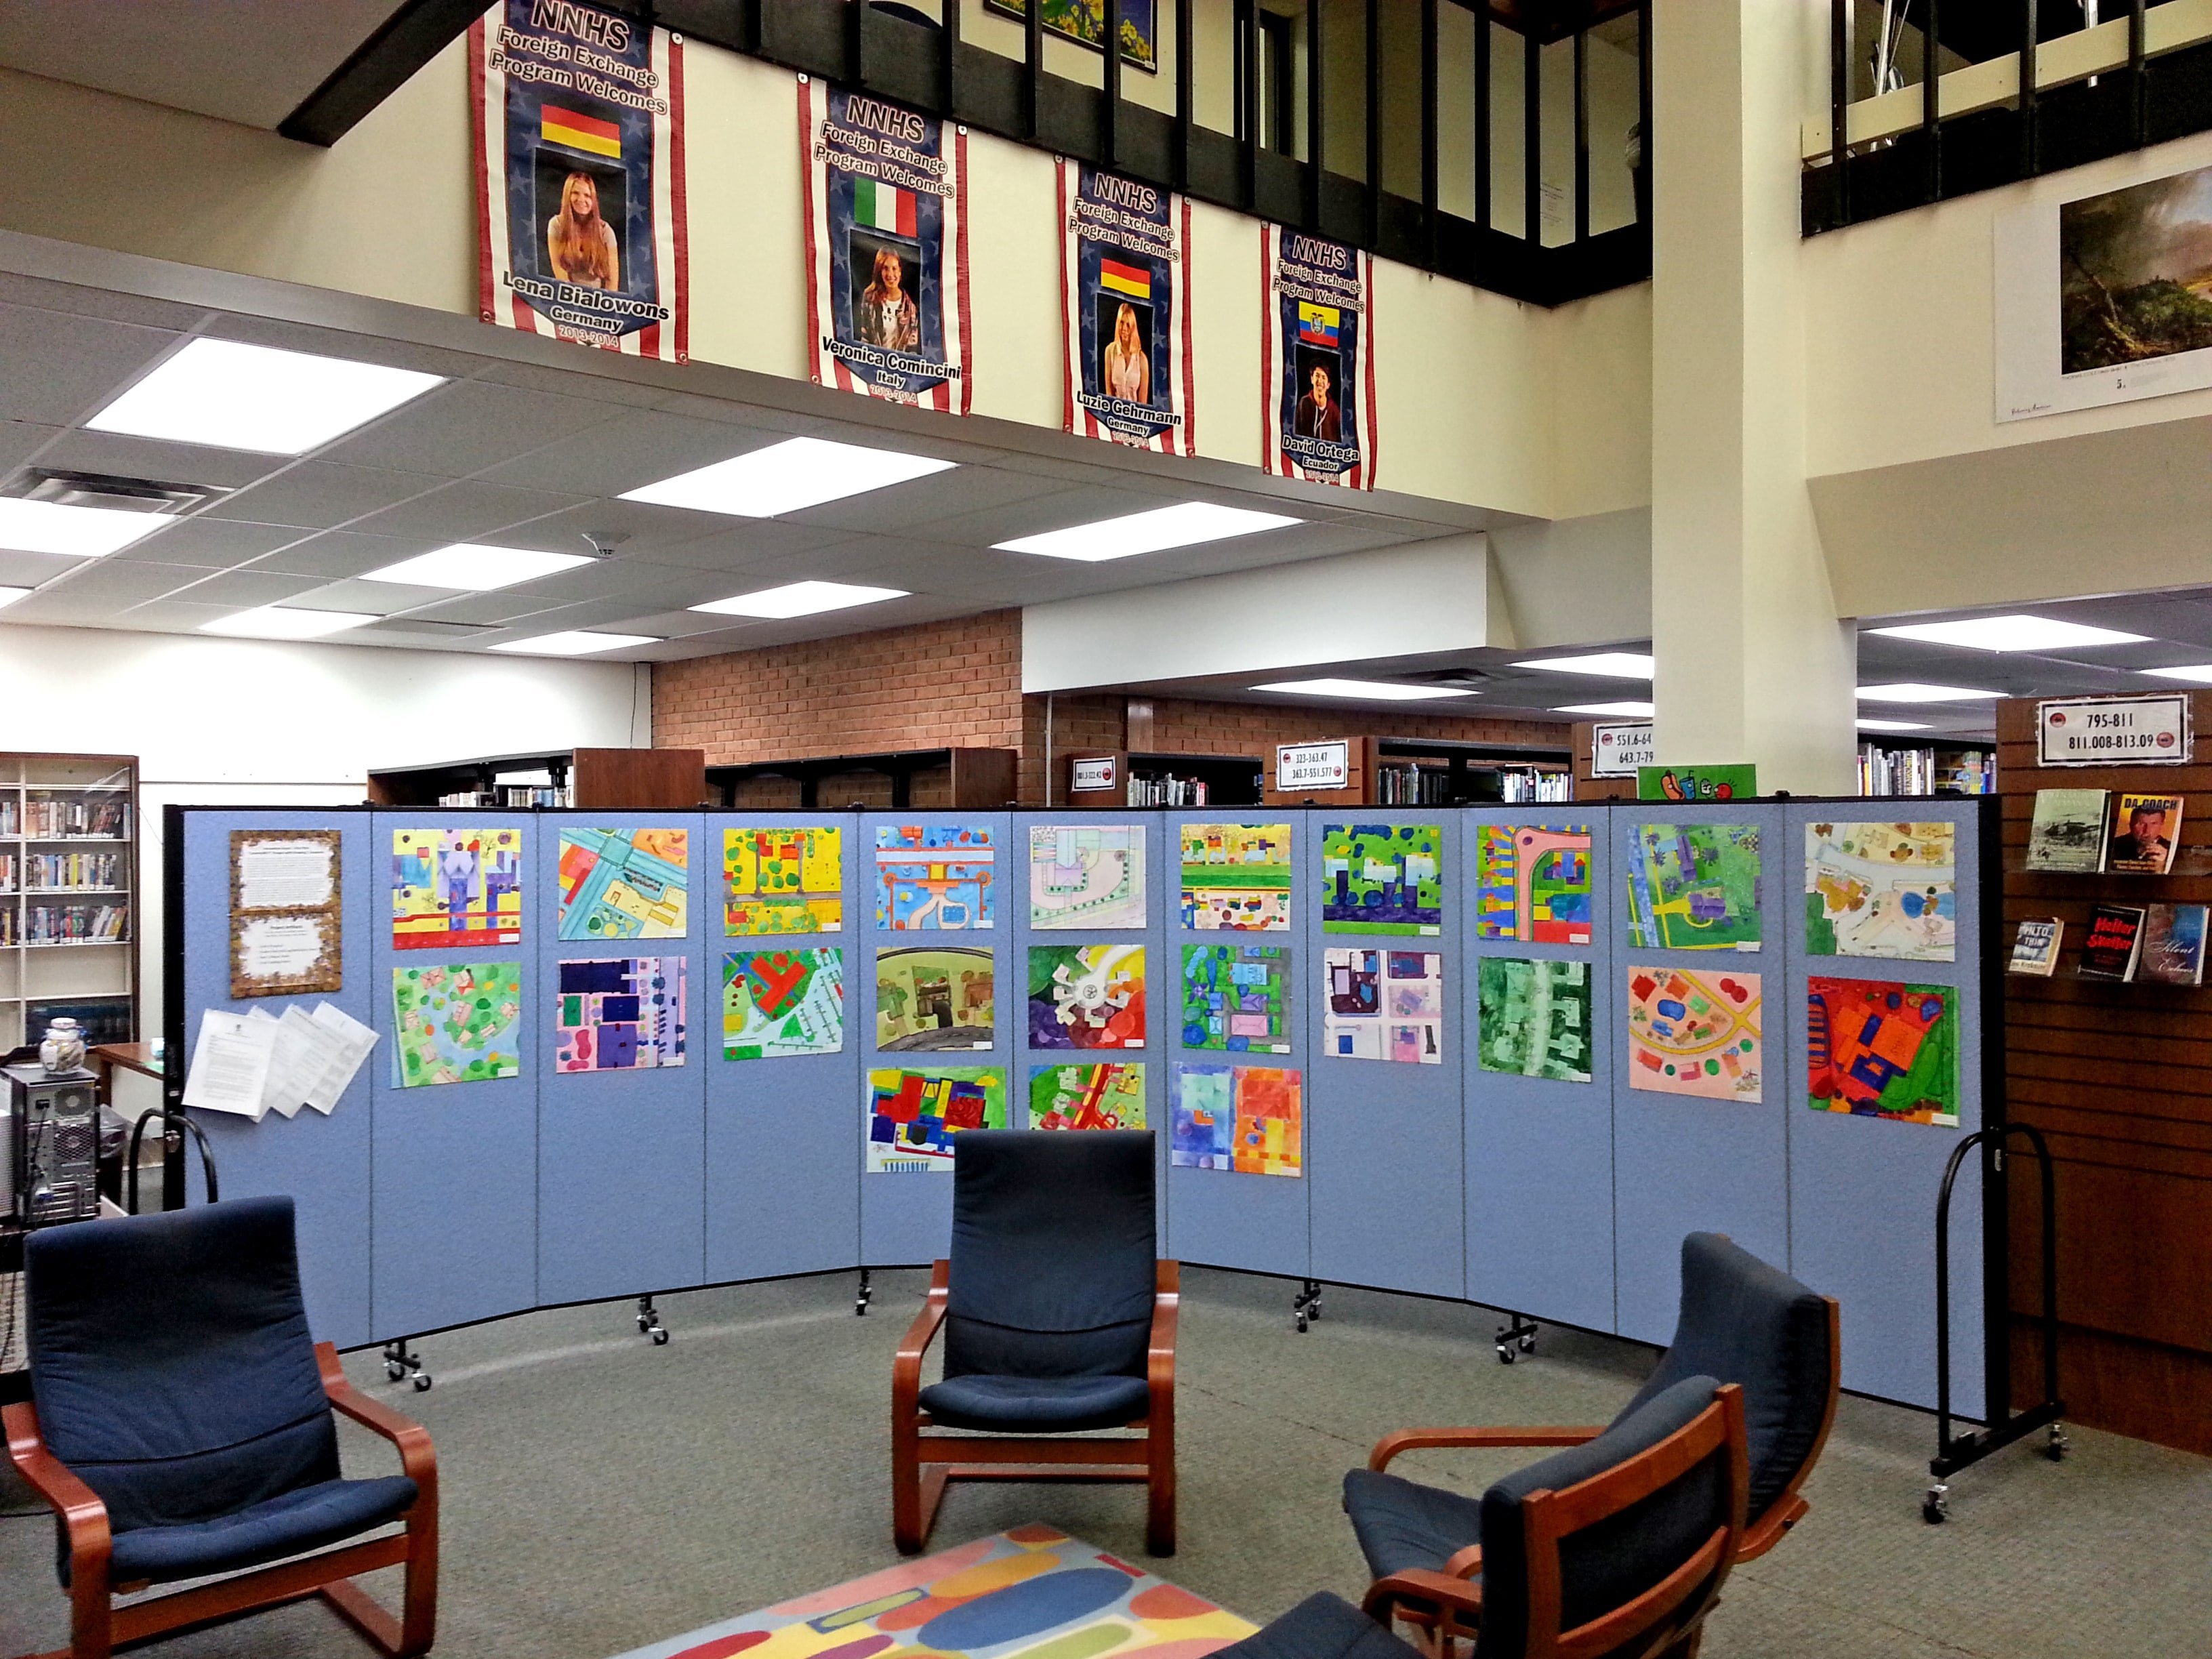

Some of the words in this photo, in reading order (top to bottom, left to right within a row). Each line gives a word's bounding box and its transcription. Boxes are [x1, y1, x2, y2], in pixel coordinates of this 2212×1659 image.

[532, 0, 629, 51] NNHS
[497, 24, 569, 60] Foreign
[575, 46, 659, 87] Exchange
[490, 50, 572, 87] Program
[577, 73, 667, 114] Welcomes
[848, 96, 924, 143] NNHS
[821, 121, 876, 152] Foreign
[880, 141, 947, 174] Exchange
[814, 143, 878, 175] Program
[882, 163, 954, 197] Welcomes
[1094, 172, 1157, 213] NNHS
[1073, 196, 1118, 224] Foreign
[1120, 213, 1174, 241] Exchange
[1068, 216, 1119, 244] Program
[1122, 233, 1179, 263] Welcomes
[1292, 235, 1346, 270] NNHS
[1277, 258, 1312, 281] Foreign
[1314, 271, 1362, 293] Exchange
[503, 271, 552, 298] Lena
[558, 284, 670, 320] Bialowons
[1273, 276, 1313, 300] Program
[1314, 289, 1364, 313] Welcomes
[551, 307, 622, 332] Germany
[560, 326, 618, 347] 2013-2014
[823, 337, 884, 365] Veronica
[886, 354, 962, 380] Comincini
[870, 385, 917, 403] 2013-2014
[877, 371, 905, 389] Italy
[1077, 391, 1110, 411] Luzie
[1112, 401, 1181, 426] Gehrmann
[1107, 416, 1150, 436] Germany
[1283, 435, 1314, 454] David
[1316, 444, 1360, 461] Ortega
[1303, 457, 1339, 471] Ecuador
[2087, 712, 2133, 728] 795-811
[1296, 752, 1328, 764] 323-363.47
[2068, 734, 2154, 750] 811.008-813.09
[1292, 766, 1332, 779] 363.7-551.577
[2124, 798, 2139, 809] DA
[2142, 798, 2177, 810] COACH
[2095, 917, 2137, 935] Helter
